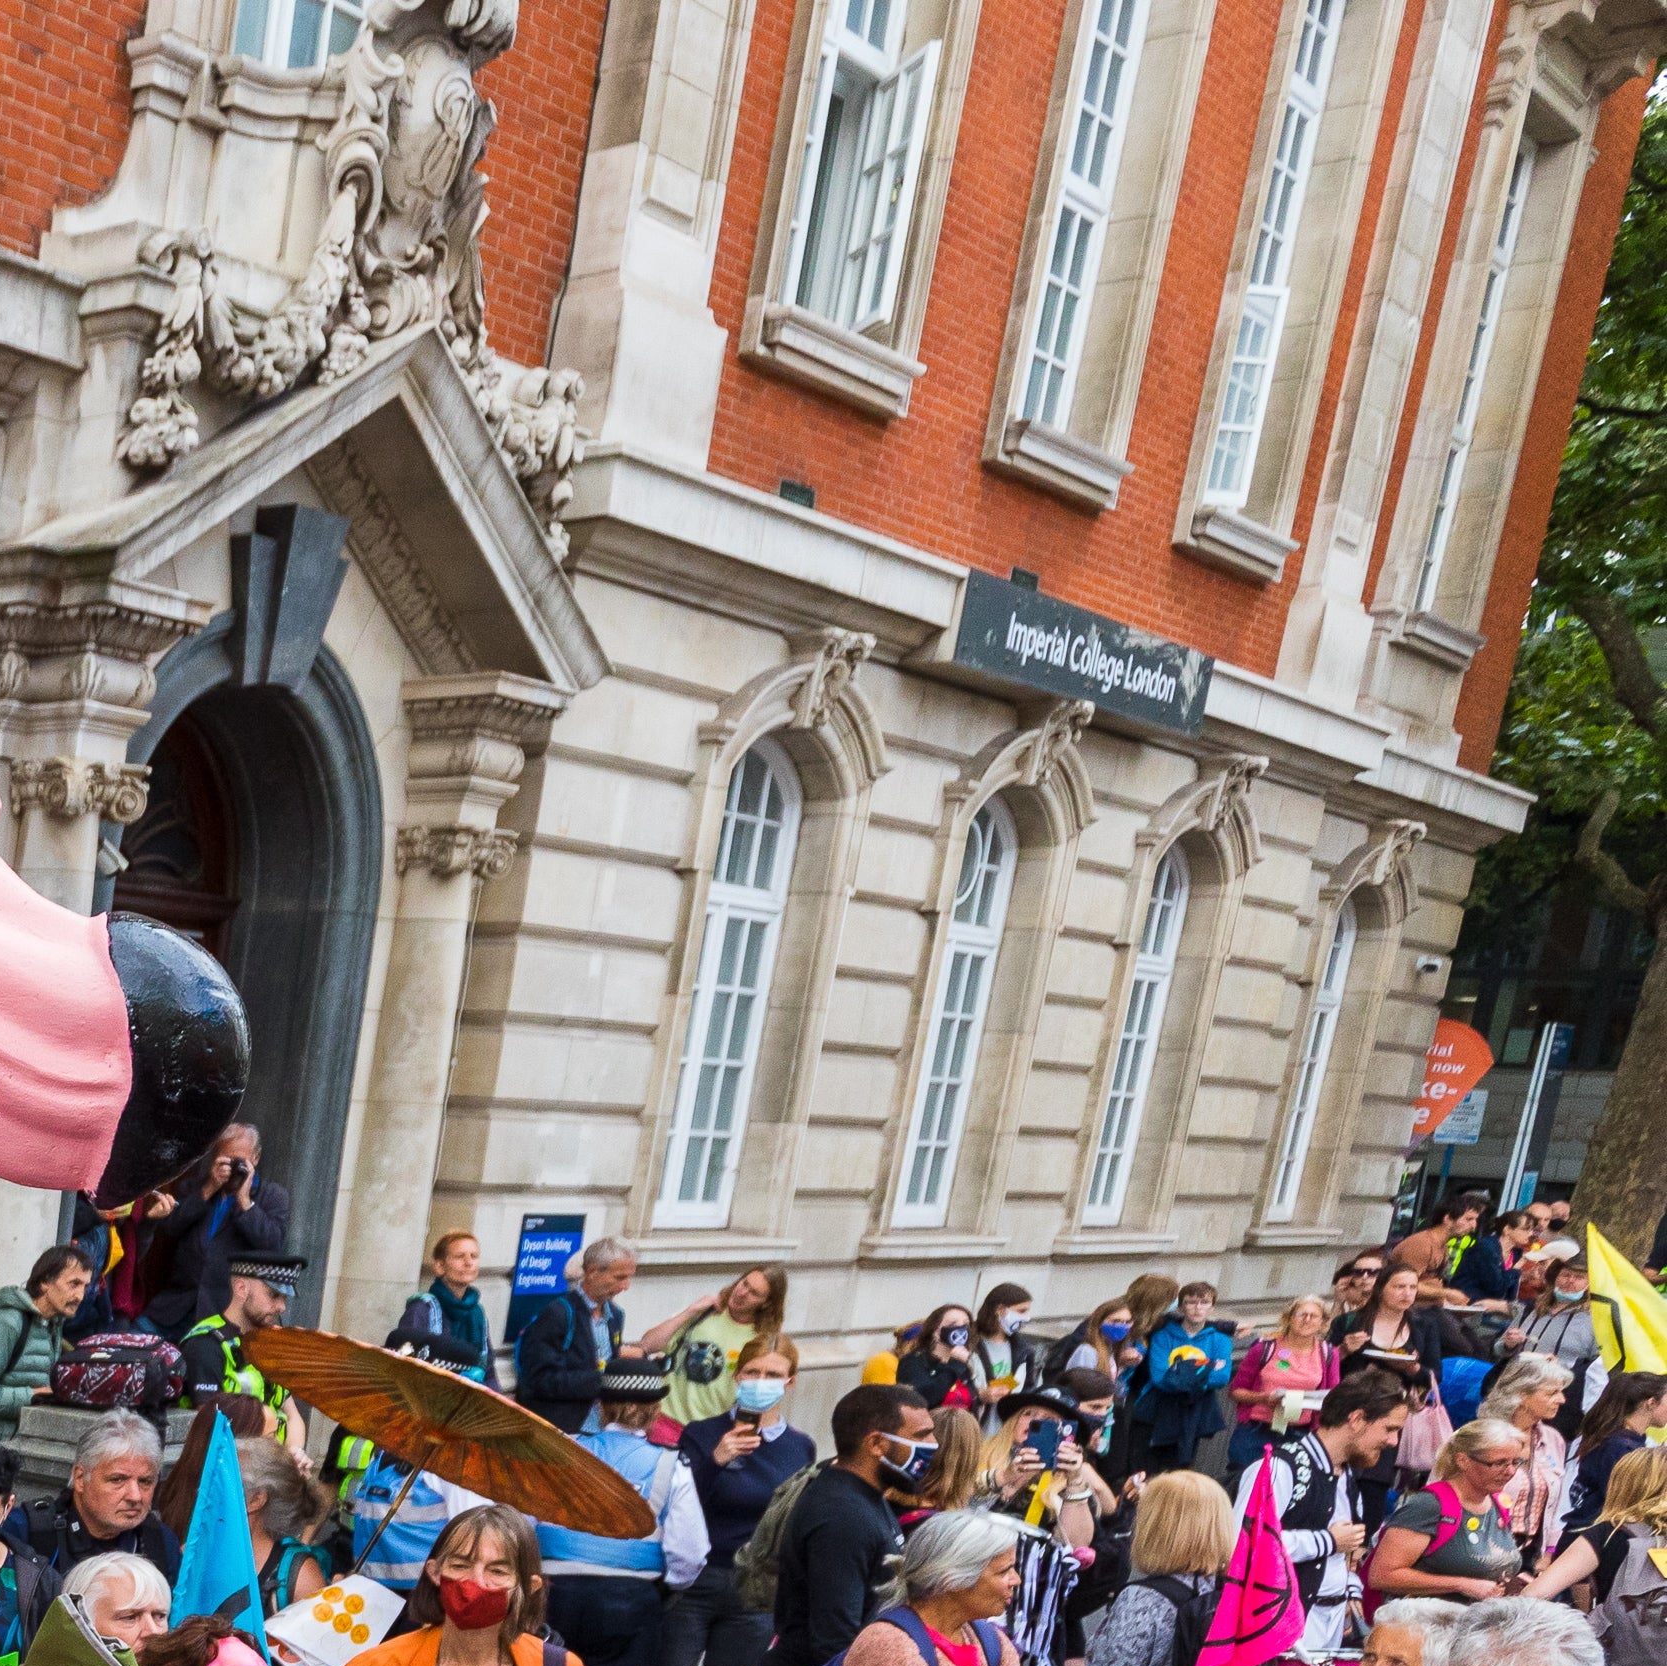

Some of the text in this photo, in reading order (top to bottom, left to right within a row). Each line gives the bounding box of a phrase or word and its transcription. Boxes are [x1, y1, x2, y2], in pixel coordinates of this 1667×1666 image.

[1005, 611, 1177, 704] Imperial College London
[1431, 1062, 1466, 1074] now
[523, 1238, 572, 1254] Dyson Building
[521, 1256, 529, 1268] of
[196, 1383, 218, 1391] POLICE
